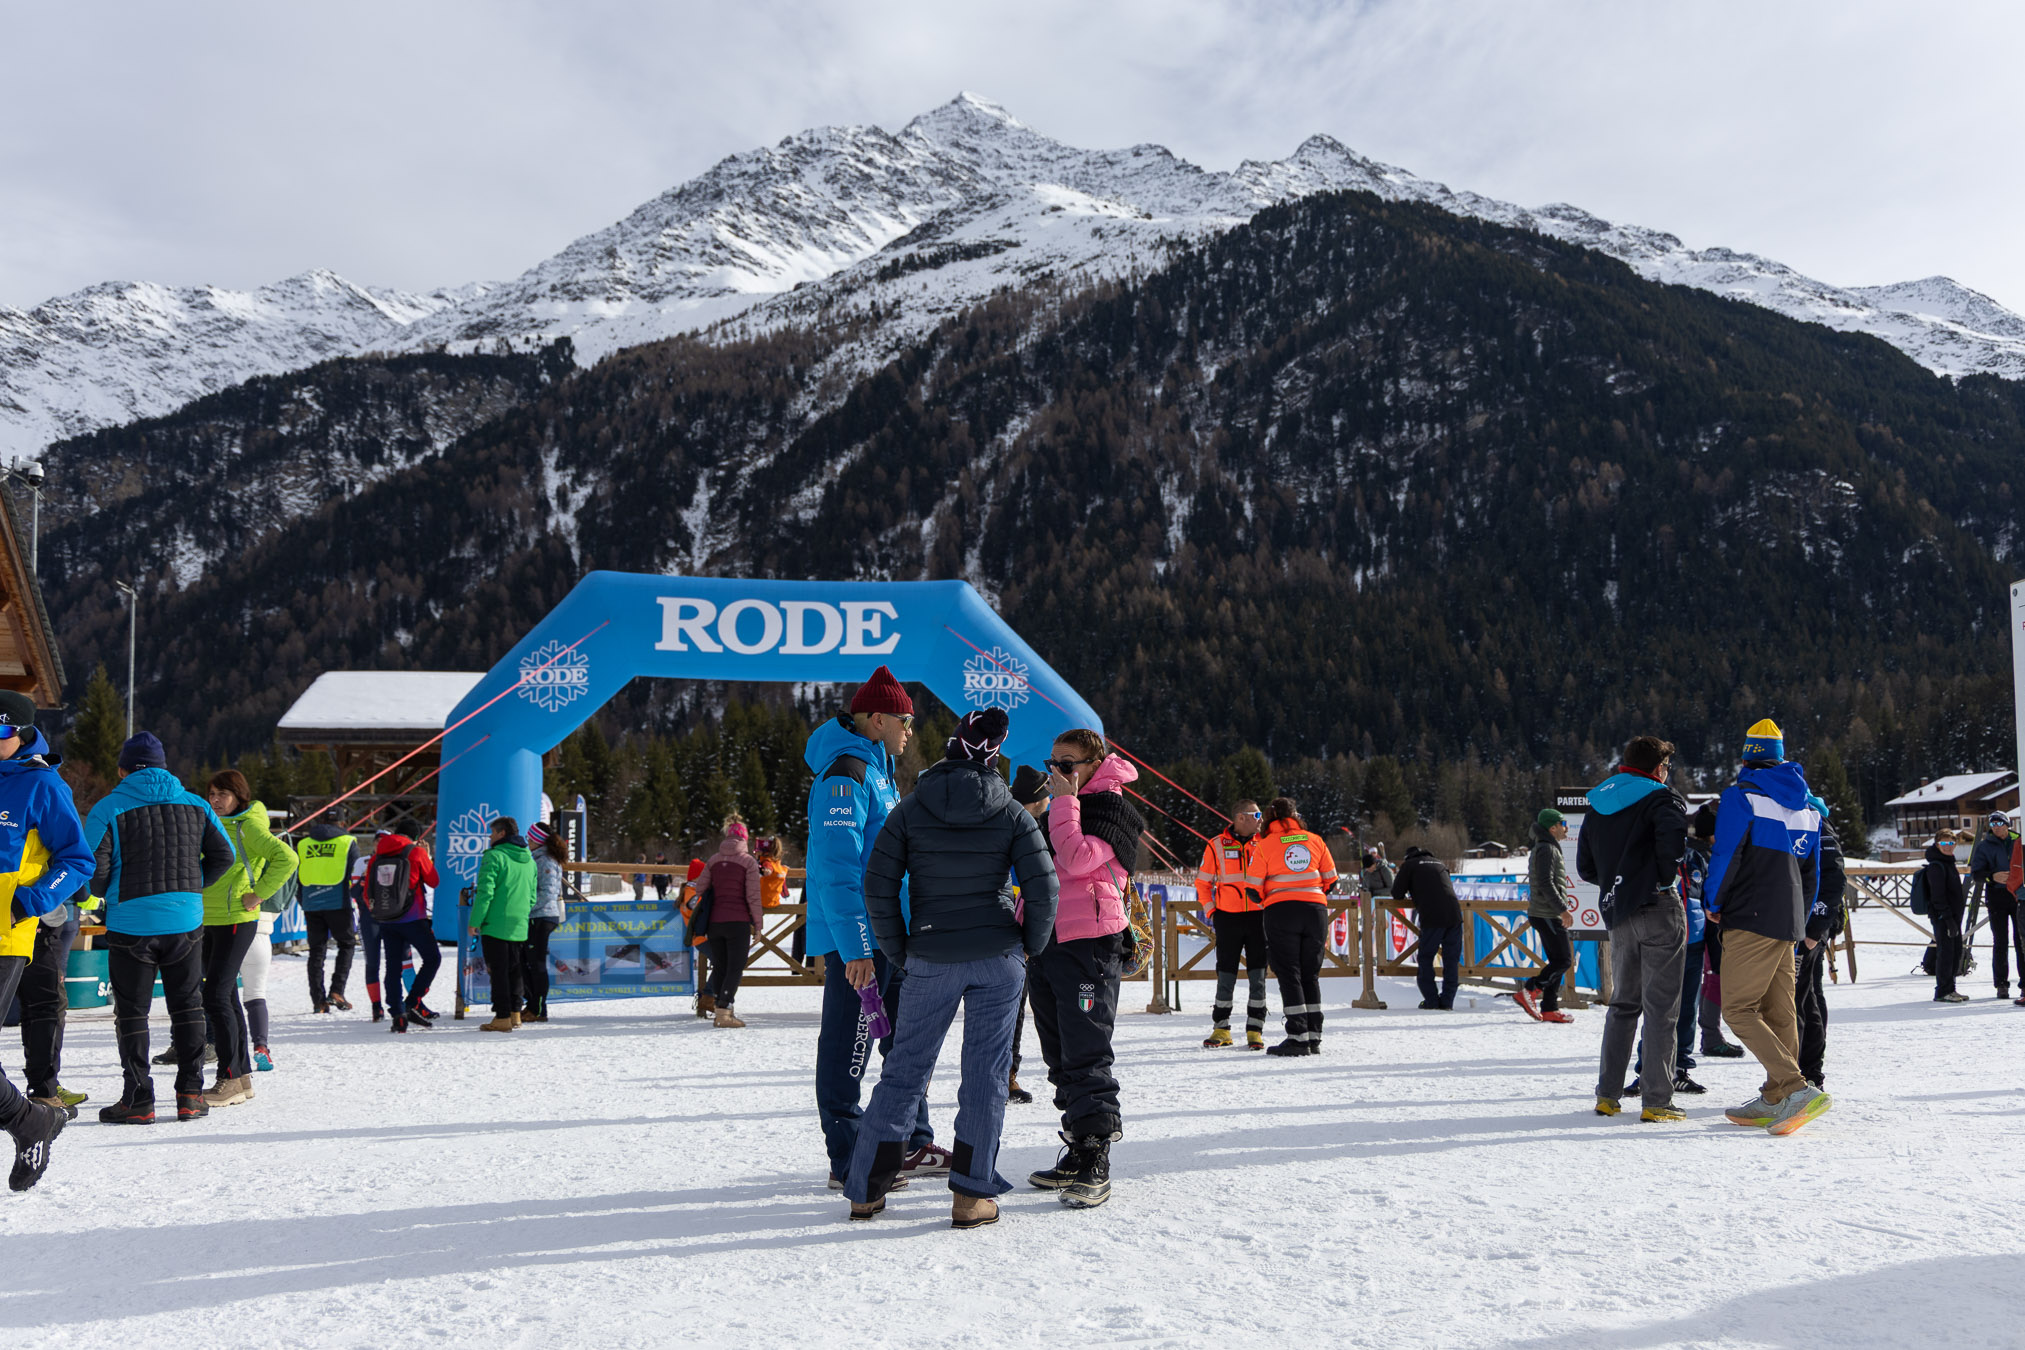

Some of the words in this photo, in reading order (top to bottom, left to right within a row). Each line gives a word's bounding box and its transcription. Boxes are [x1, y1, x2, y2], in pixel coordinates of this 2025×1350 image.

[655, 596, 901, 655] RODE
[520, 668, 588, 685] RODE
[964, 673, 1029, 690] RODE
[1557, 796, 1591, 806] PARTEN
[829, 806, 852, 815] enel
[857, 921, 872, 956] Audi
[849, 1006, 869, 1078] SERCITO
